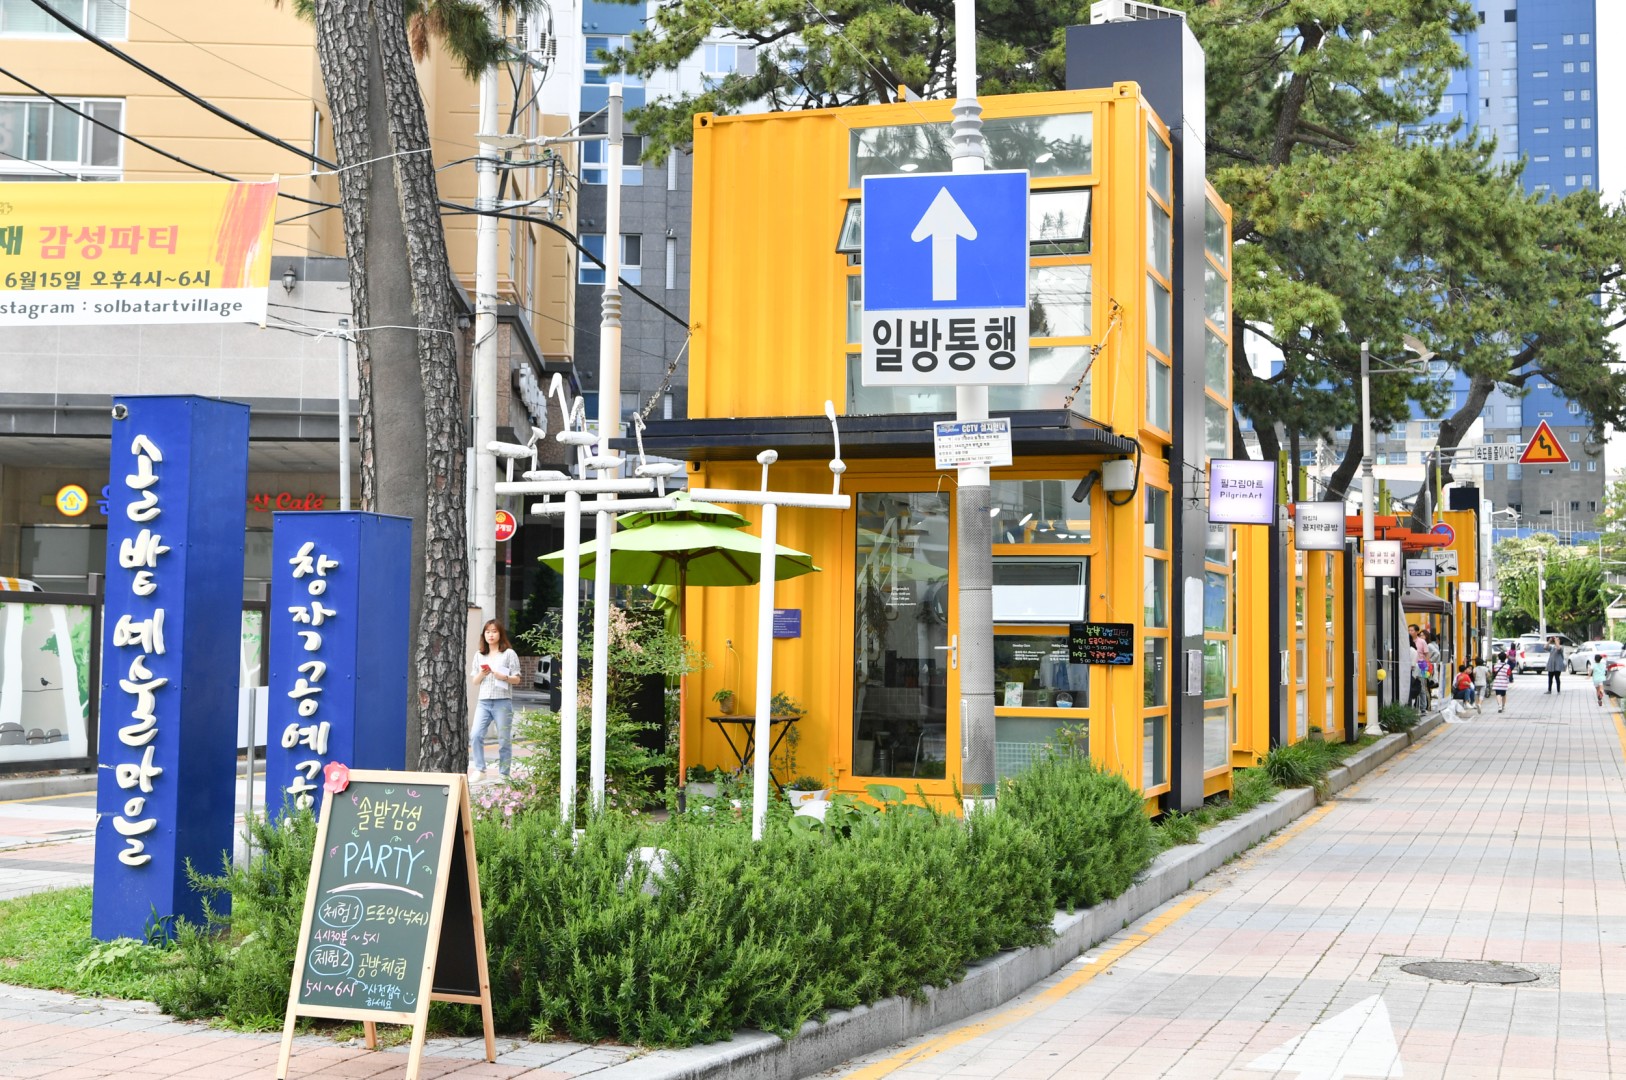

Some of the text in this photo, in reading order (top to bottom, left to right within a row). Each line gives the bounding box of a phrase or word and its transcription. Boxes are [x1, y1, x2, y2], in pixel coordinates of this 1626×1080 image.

[39, 225, 179, 260] 감성파티
[5, 270, 211, 290] 6월15일 오후4시~6시
[0, 301, 75, 320] stagram
[94, 298, 243, 317] solbatartvillage
[873, 316, 1016, 373] 일방통행
[962, 424, 978, 433] CCTV
[1220, 478, 1264, 489] 필그림아트
[276, 492, 326, 511] Café
[1219, 491, 1263, 499] PilgrimArt
[281, 541, 339, 828] 창작공예공
[357, 796, 422, 831] 솔밭감성
[343, 841, 424, 884] PARTY
